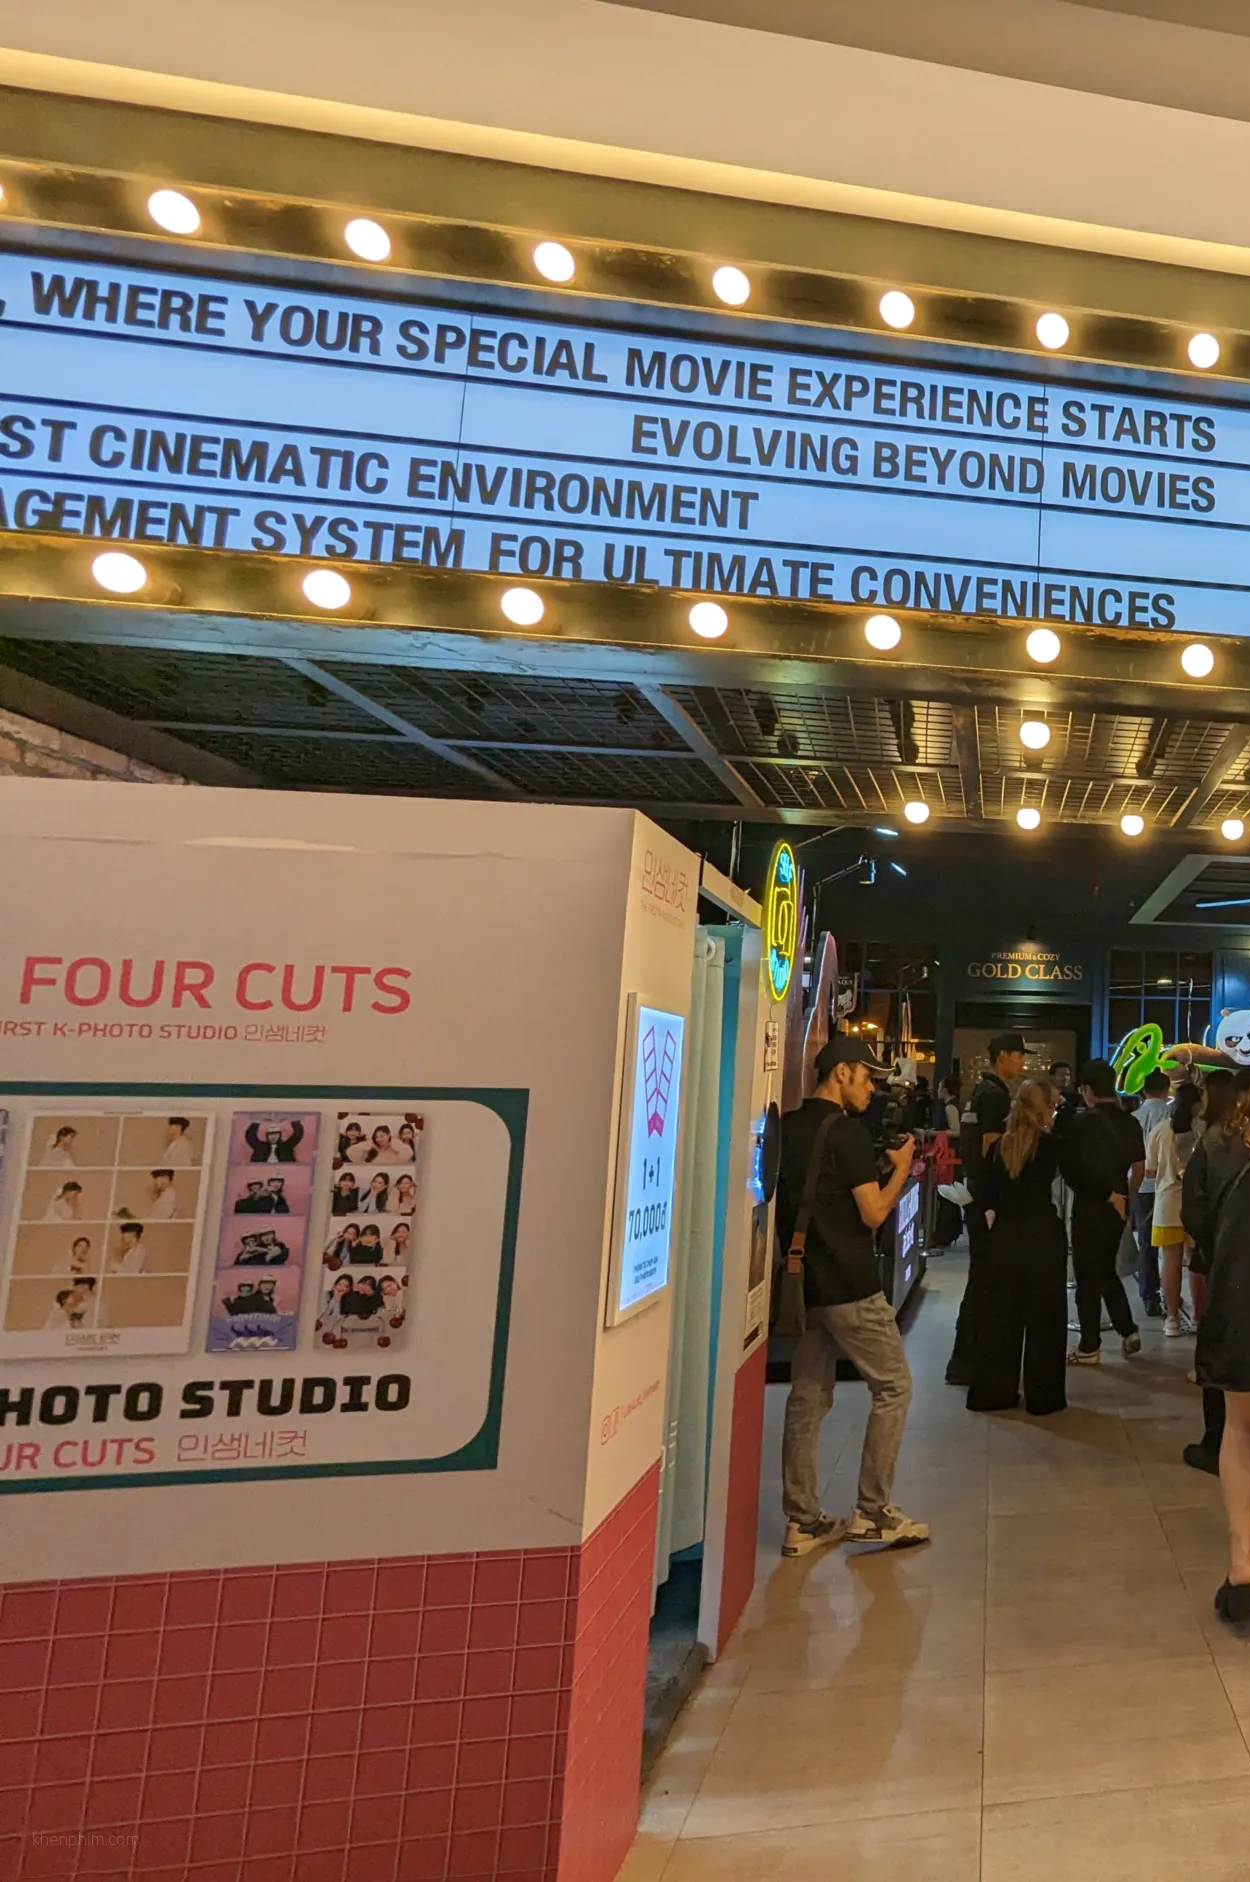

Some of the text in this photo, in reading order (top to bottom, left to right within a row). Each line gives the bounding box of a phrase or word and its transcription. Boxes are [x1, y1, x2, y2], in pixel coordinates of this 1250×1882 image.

[31, 271, 1216, 453] WHERE YOUR SPECIAL MOVIE EXPERIENCE STARTS
[89, 424, 390, 494] CINEMATIC
[408, 459, 759, 530] ENVIRONMENT
[631, 416, 1216, 513] EVOLVING BEYOND MOVIES
[251, 510, 465, 568] SYSTEM
[489, 533, 583, 579] FOR
[603, 543, 835, 601] ULTIMATE
[851, 565, 1176, 629] CONVENIENCES
[19, 956, 412, 1014] FOUR CUTS
[967, 962, 1083, 980] GOLD CLASS
[53, 1022, 153, 1039] K-PHOTO
[160, 1025, 238, 1041] STUDIO
[643, 1156, 661, 1191] 1+1
[179, 1374, 412, 1420] STUDIO
[53, 1437, 156, 1470] CUTS
